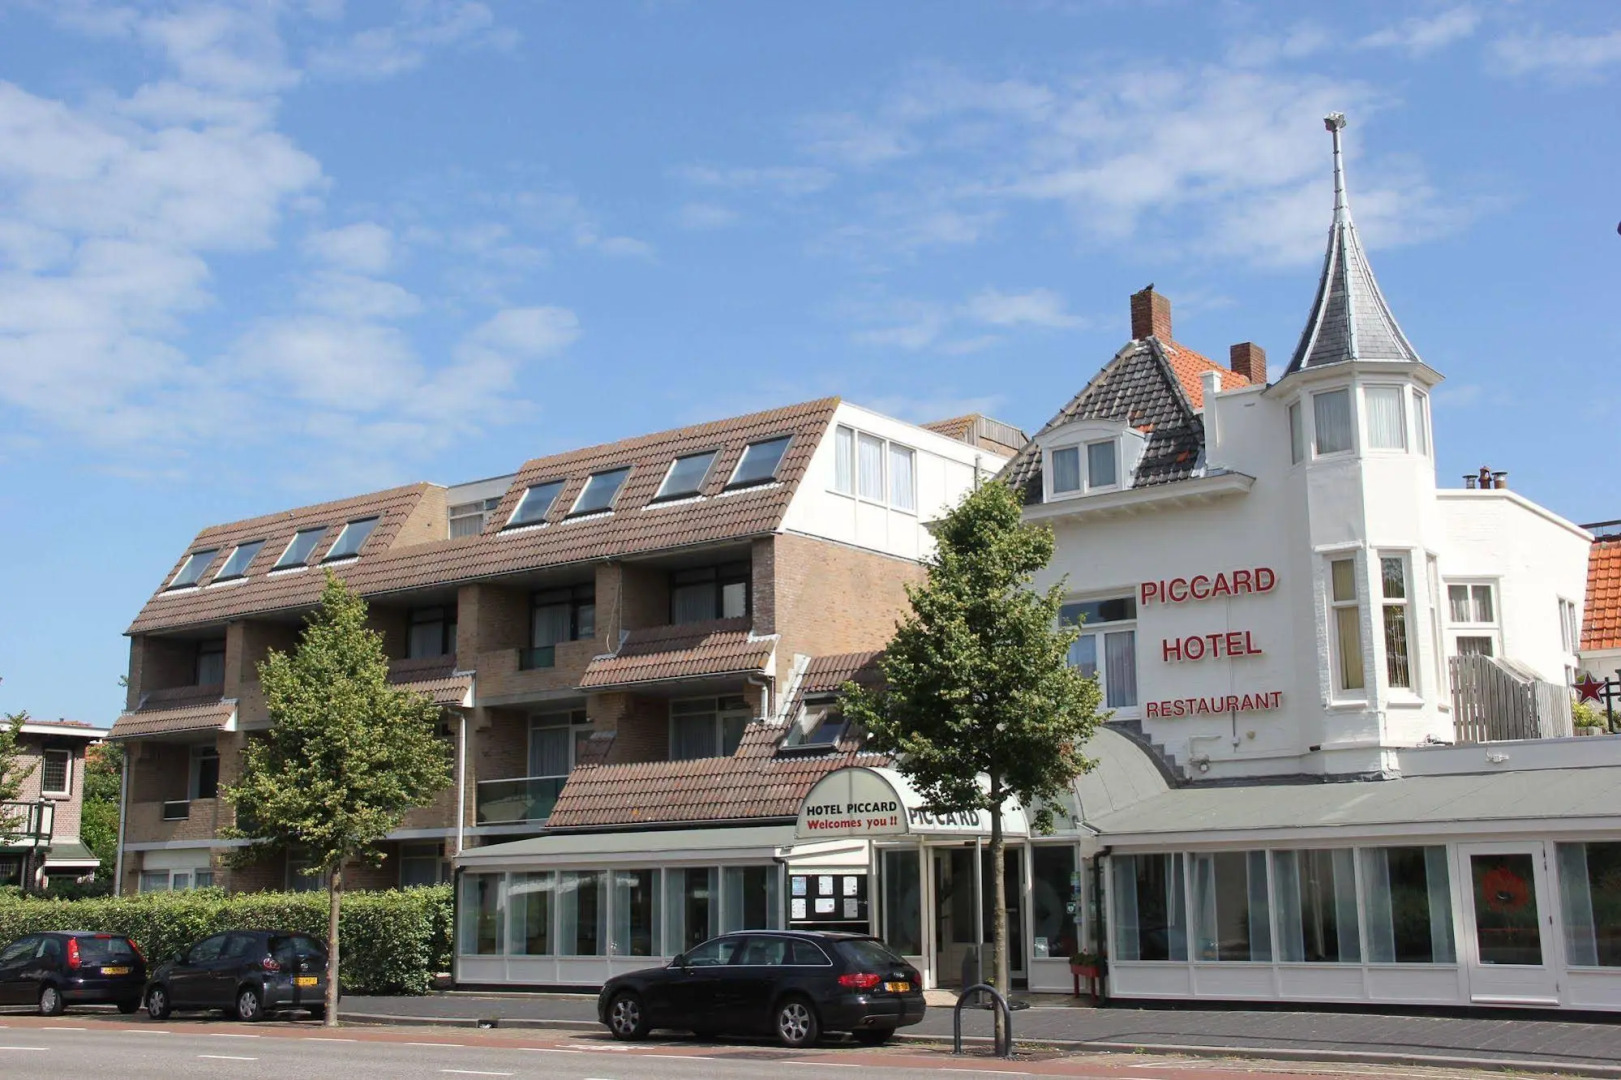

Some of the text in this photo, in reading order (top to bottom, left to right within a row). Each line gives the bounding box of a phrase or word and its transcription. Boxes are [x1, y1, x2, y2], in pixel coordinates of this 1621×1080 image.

[1140, 567, 1276, 606] PICCARD
[1162, 630, 1262, 662] HOTEL
[1146, 691, 1283, 718] RESTAURANT
[807, 801, 897, 816] HOTEL PICCARD
[807, 818, 862, 830] Welcomes
[867, 818, 887, 830] you
